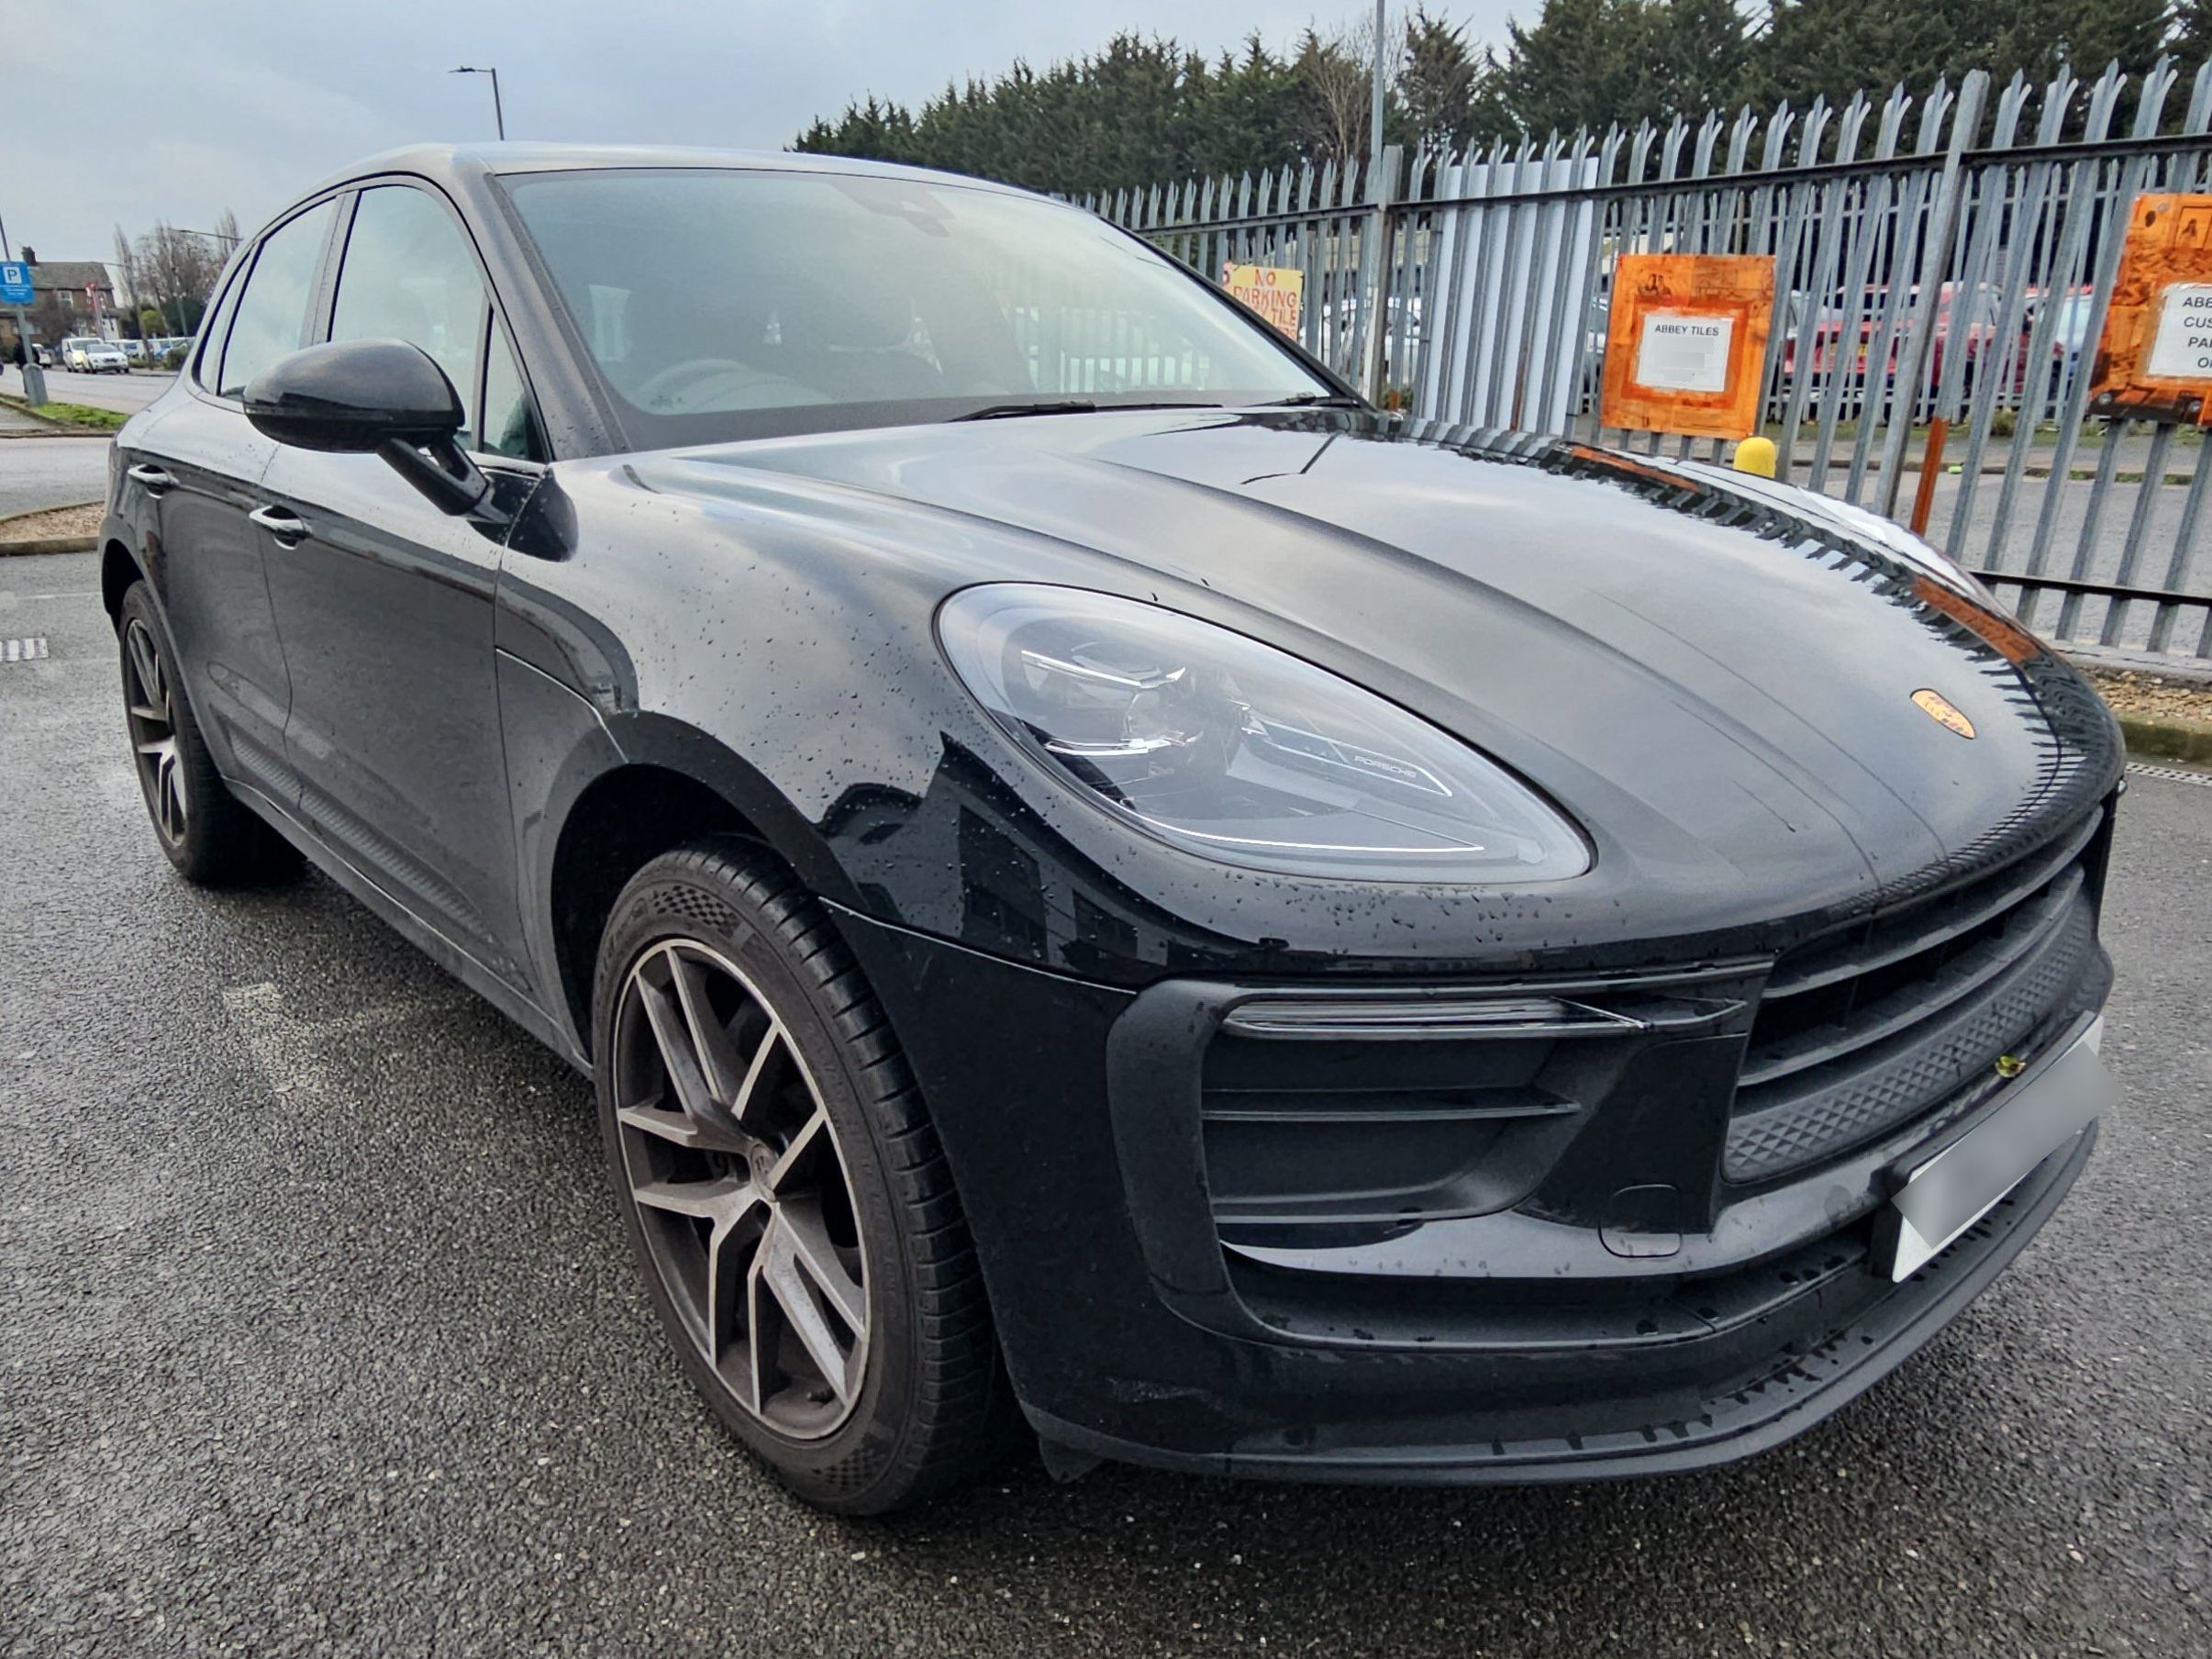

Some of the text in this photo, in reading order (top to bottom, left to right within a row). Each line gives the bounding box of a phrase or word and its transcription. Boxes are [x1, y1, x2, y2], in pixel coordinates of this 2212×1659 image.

[6, 269, 17, 282] P
[1254, 269, 1276, 286] NO
[1233, 285, 1297, 308] PARKING
[1271, 307, 1296, 327] TILE
[1654, 324, 1719, 337] ABBEY TILES
[2187, 337, 2212, 349] PA
[1354, 755, 1417, 779] PORSCHE
